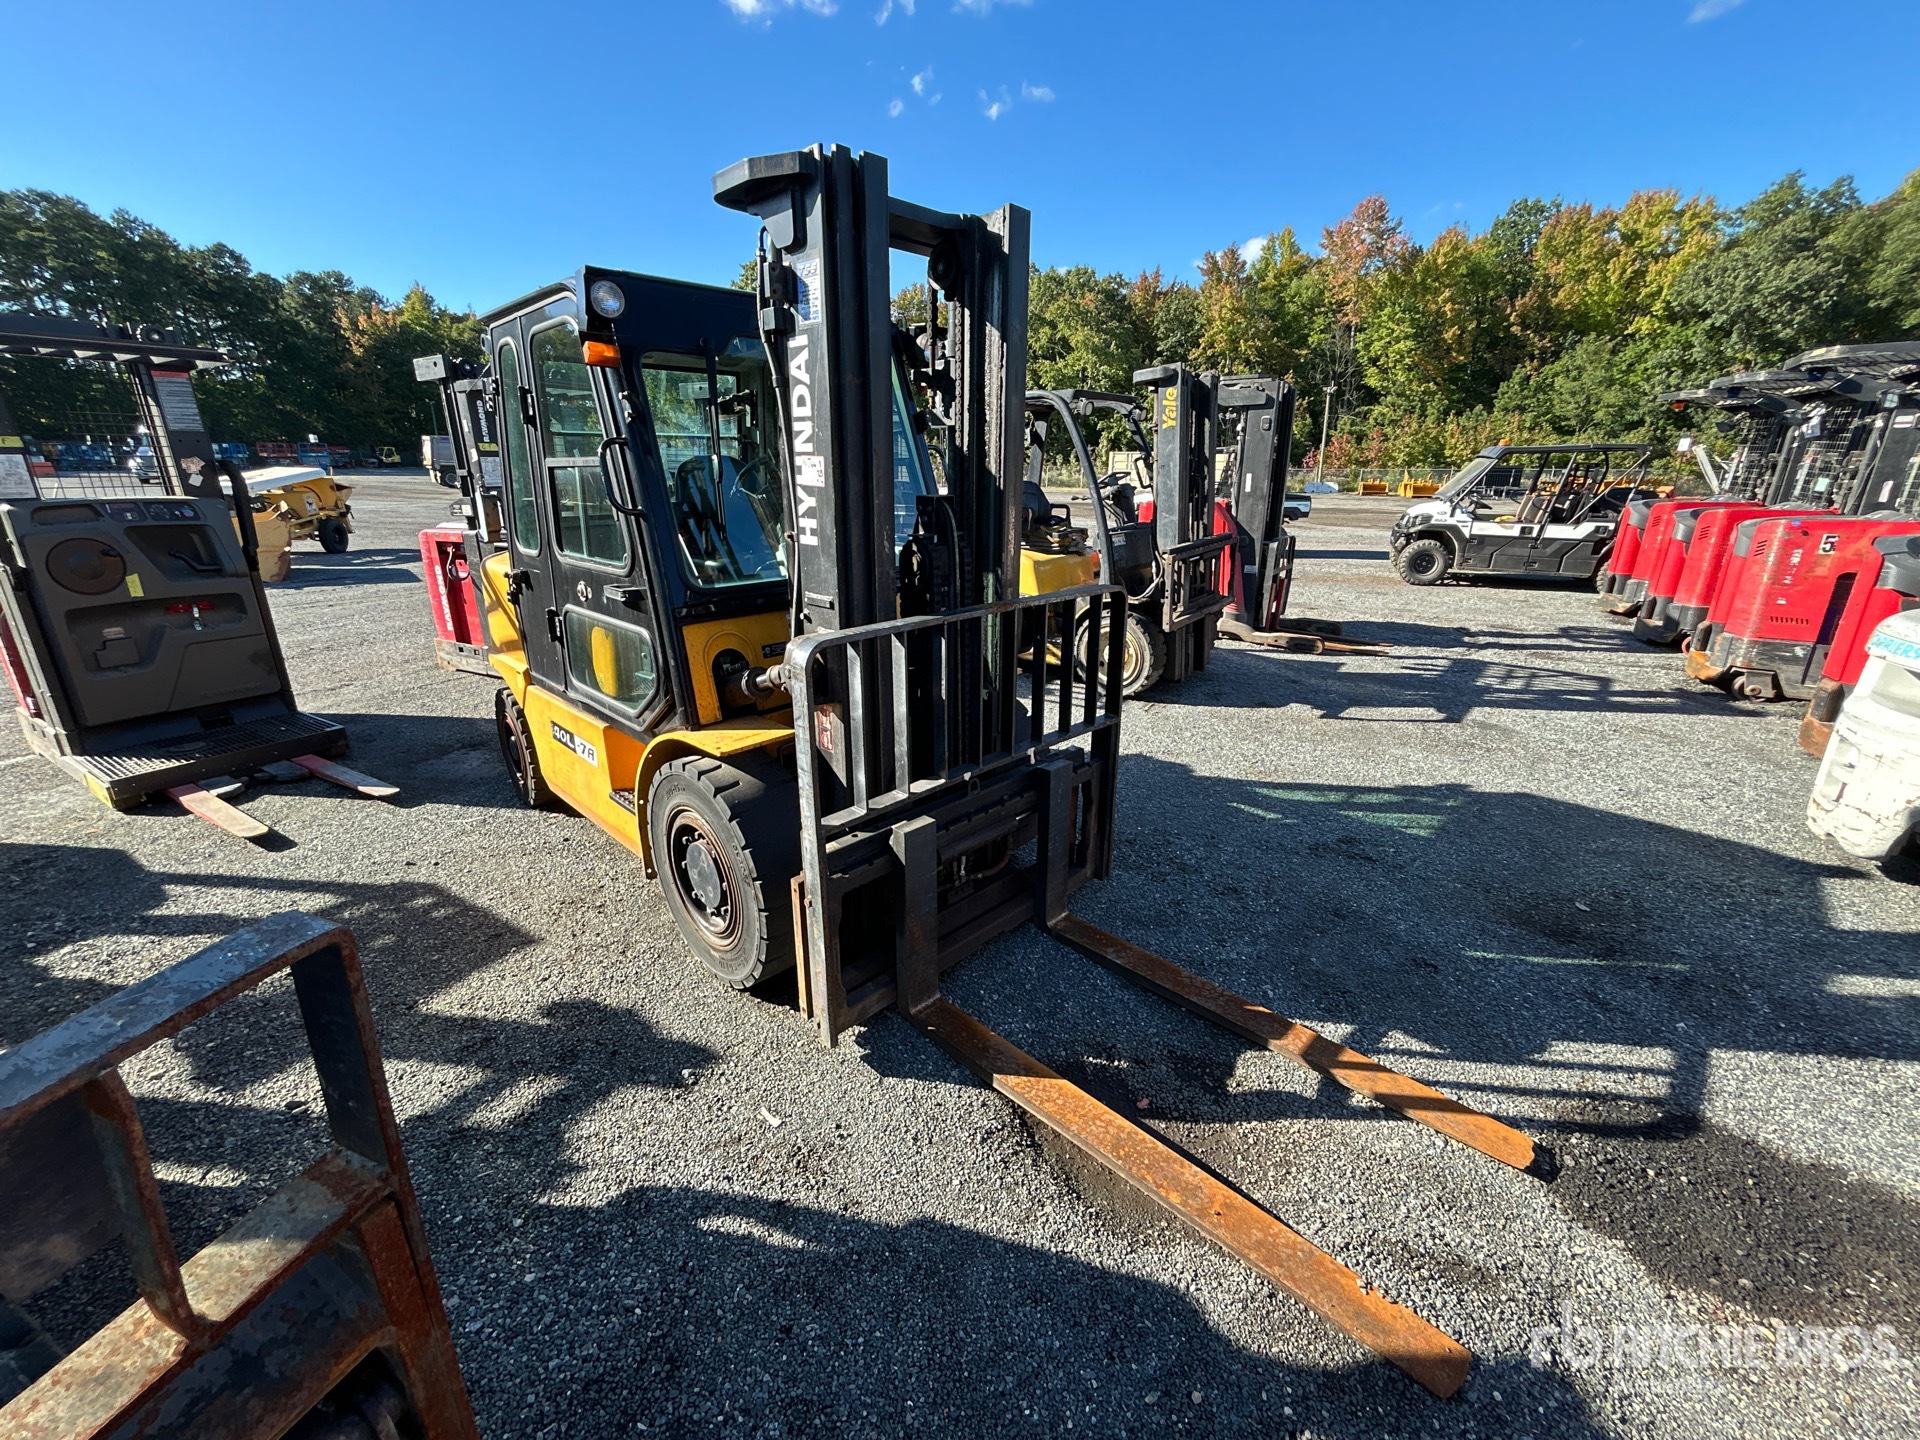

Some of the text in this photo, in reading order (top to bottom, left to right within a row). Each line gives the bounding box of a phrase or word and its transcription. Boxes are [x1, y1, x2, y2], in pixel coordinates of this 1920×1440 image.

[476, 400, 490, 443] RAYMOND
[1162, 387, 1177, 430] Yale
[788, 334, 819, 546] HYNDAI
[1821, 535, 1838, 553] 5
[435, 565, 453, 631] RAYMOND
